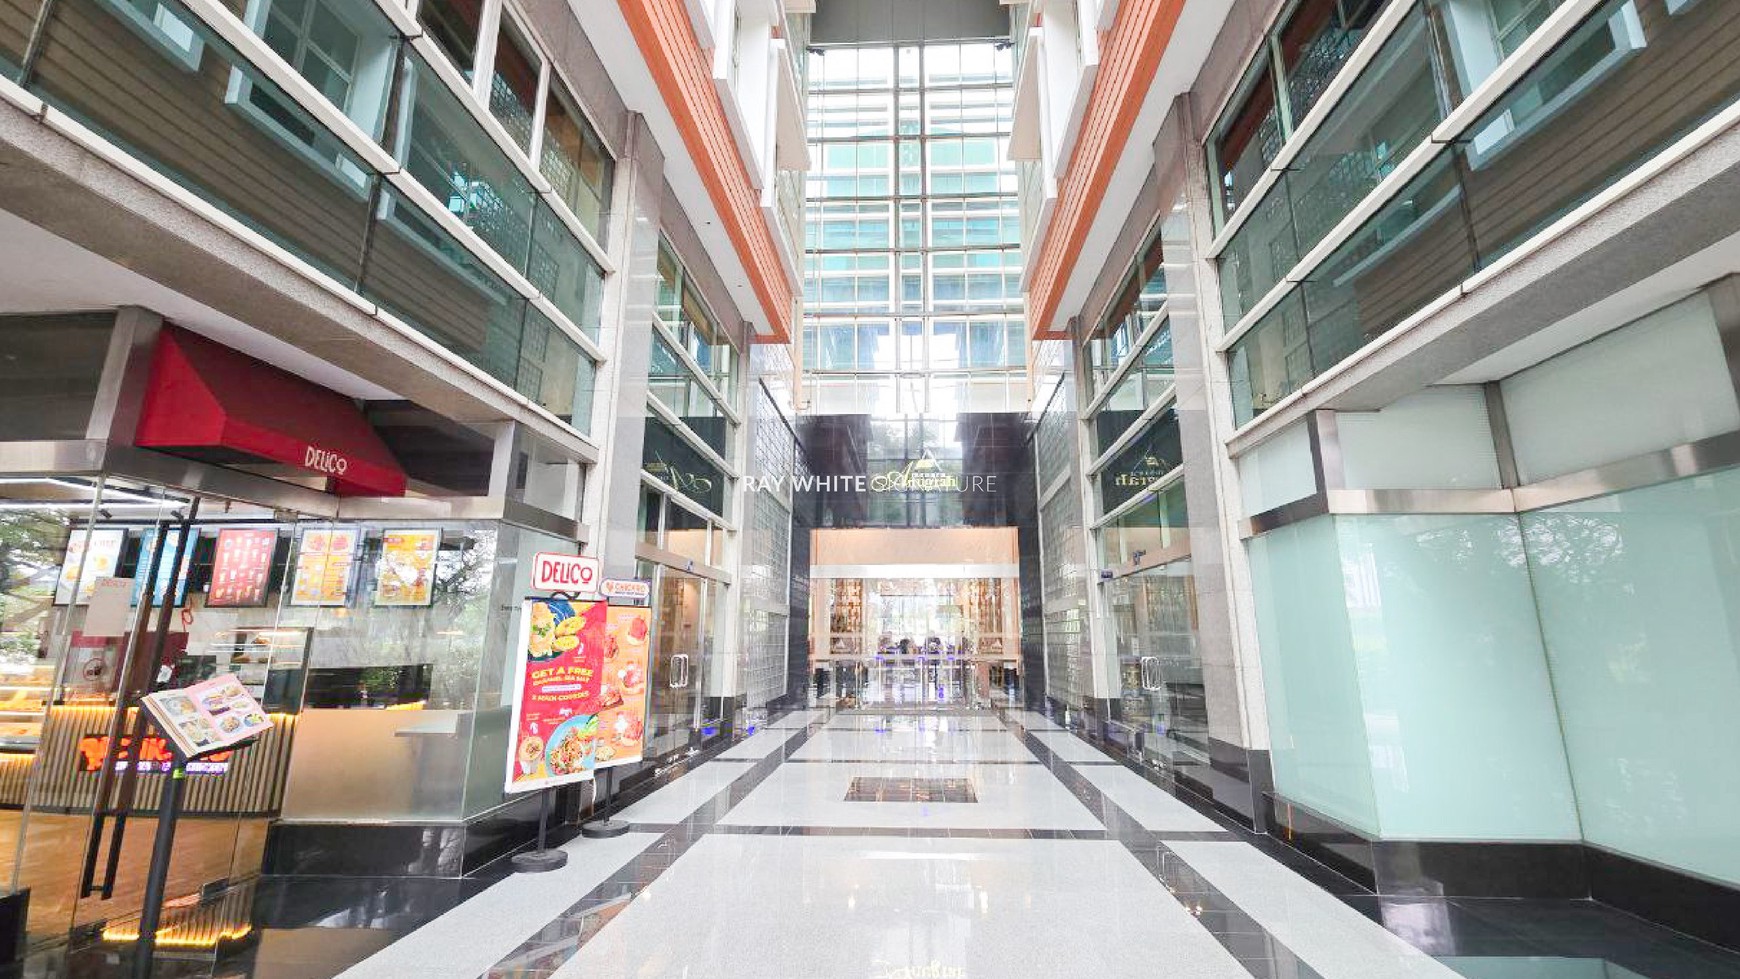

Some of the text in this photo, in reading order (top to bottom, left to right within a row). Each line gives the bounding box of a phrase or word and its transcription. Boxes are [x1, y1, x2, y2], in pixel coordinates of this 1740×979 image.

[542, 560, 593, 584] DELICO
[531, 666, 594, 679] GET A FREE
